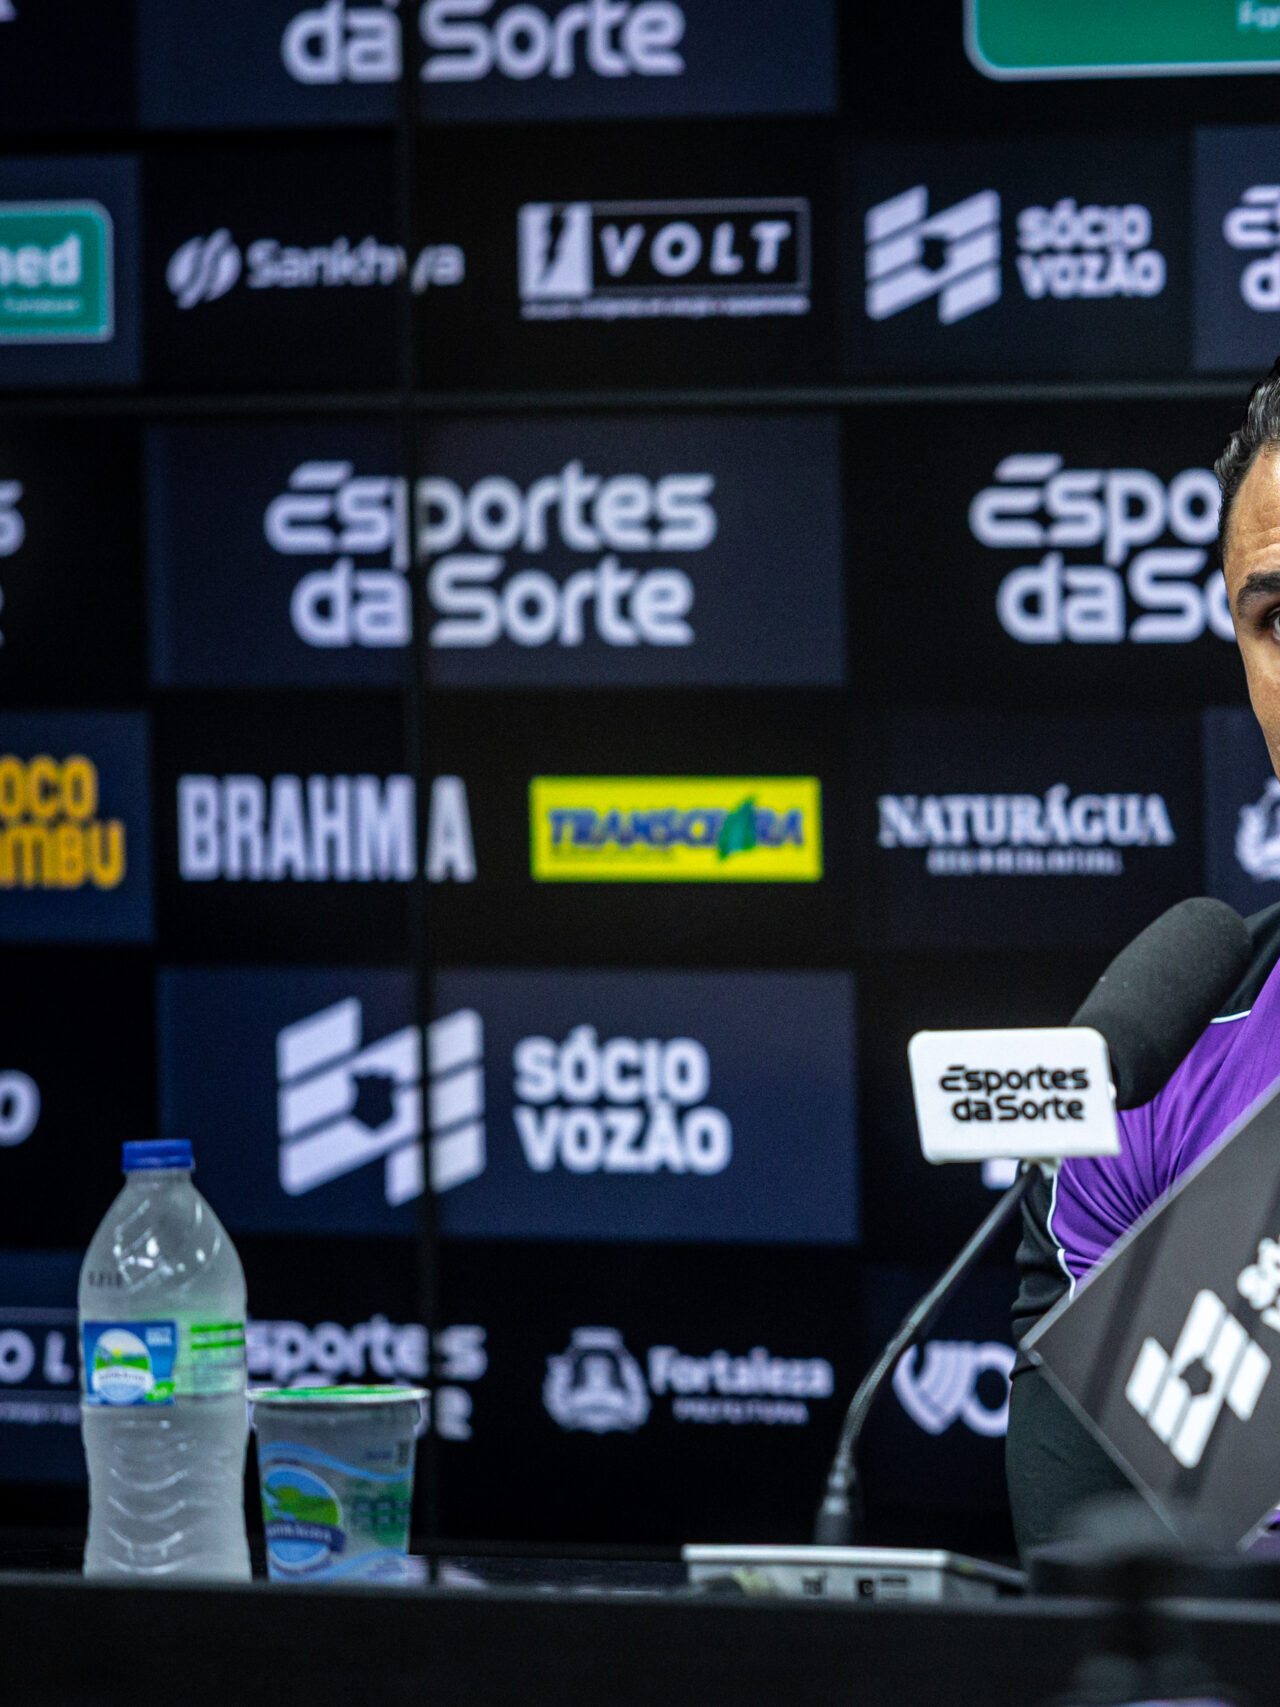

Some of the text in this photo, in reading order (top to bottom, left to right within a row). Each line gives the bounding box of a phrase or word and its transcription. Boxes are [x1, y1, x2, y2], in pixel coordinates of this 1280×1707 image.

[601, 221, 791, 277] VOLT
[1017, 198, 1152, 251] SÓCIO
[1017, 250, 1166, 299] VOZÃO
[264, 461, 718, 567] Esportes
[178, 775, 477, 883] BRAHMA
[878, 783, 1176, 849] NATURÁGUA
[513, 1025, 711, 1104] SÓCIO
[939, 1064, 1090, 1096] Esportes
[514, 1100, 733, 1176] VOZÃO
